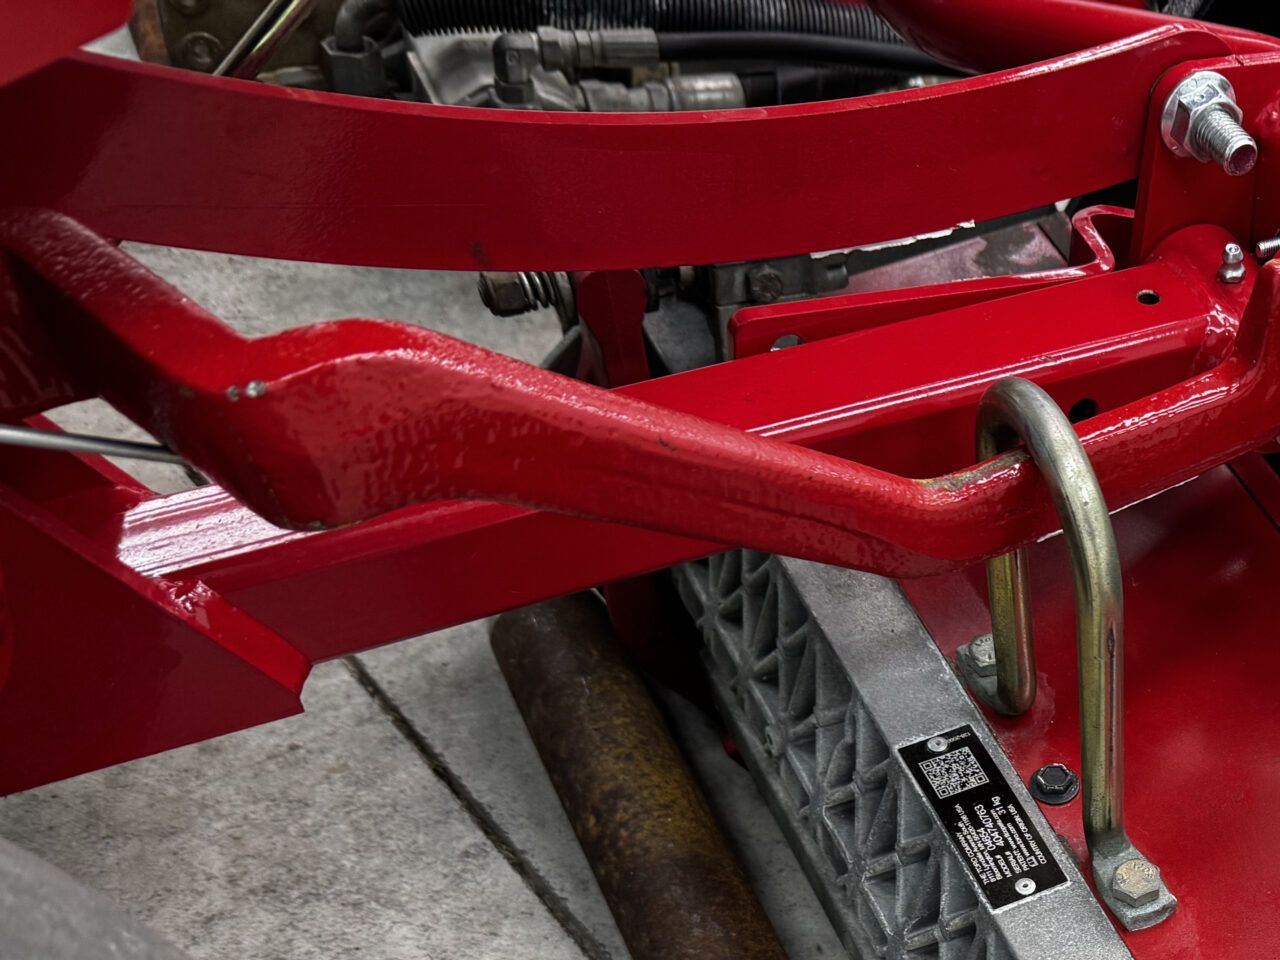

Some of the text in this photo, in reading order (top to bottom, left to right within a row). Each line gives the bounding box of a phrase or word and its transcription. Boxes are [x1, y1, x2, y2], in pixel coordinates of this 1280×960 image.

[955, 804, 964, 815] USA
[991, 796, 1006, 815] 31 kg
[1007, 804, 1017, 815] USA
[975, 805, 1004, 846] 404740763
[976, 840, 985, 850] MN
[977, 828, 996, 850] 04654
[956, 832, 990, 885] THE TORO COMPANY
[1028, 840, 1047, 864] COUNTRY
